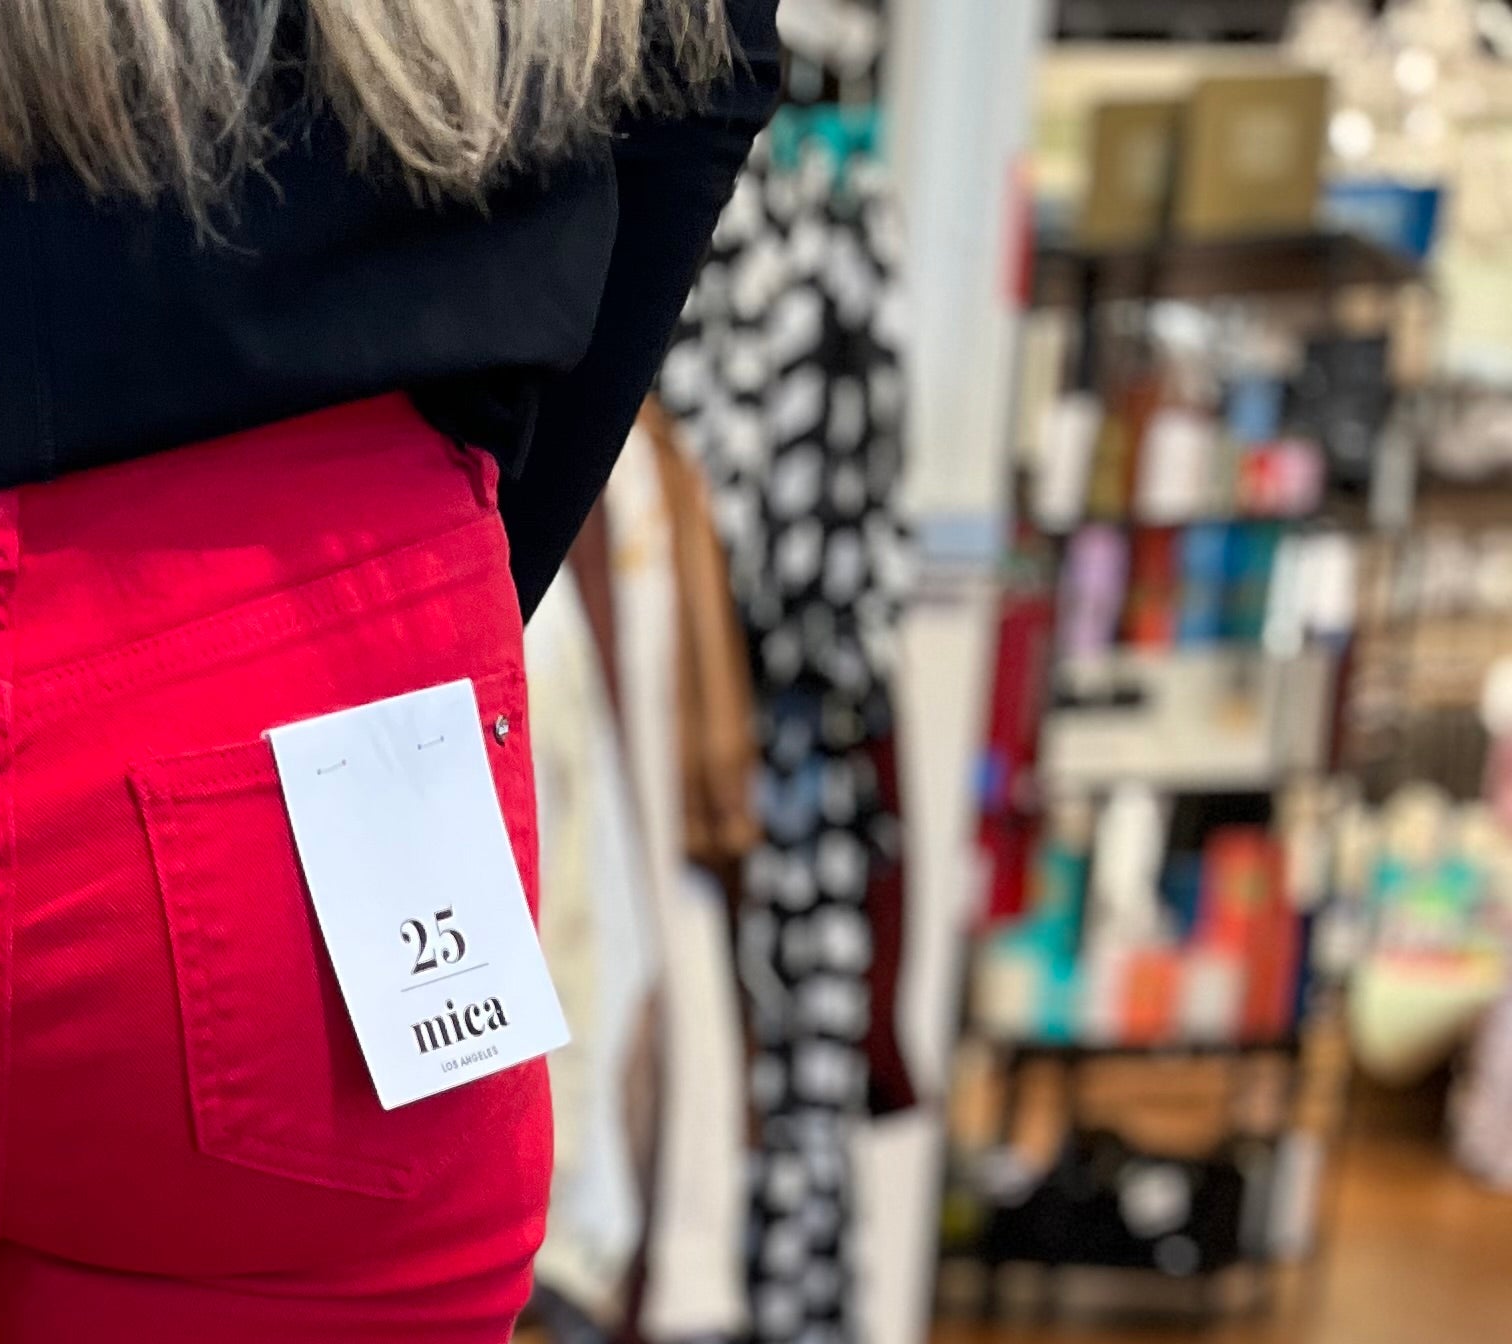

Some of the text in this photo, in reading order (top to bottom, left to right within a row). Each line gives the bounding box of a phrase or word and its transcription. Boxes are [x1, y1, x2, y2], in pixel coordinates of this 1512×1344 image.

[399, 904, 466, 975] 25
[410, 996, 509, 1055] mica
[441, 1045, 499, 1073] LOS ANGELES
